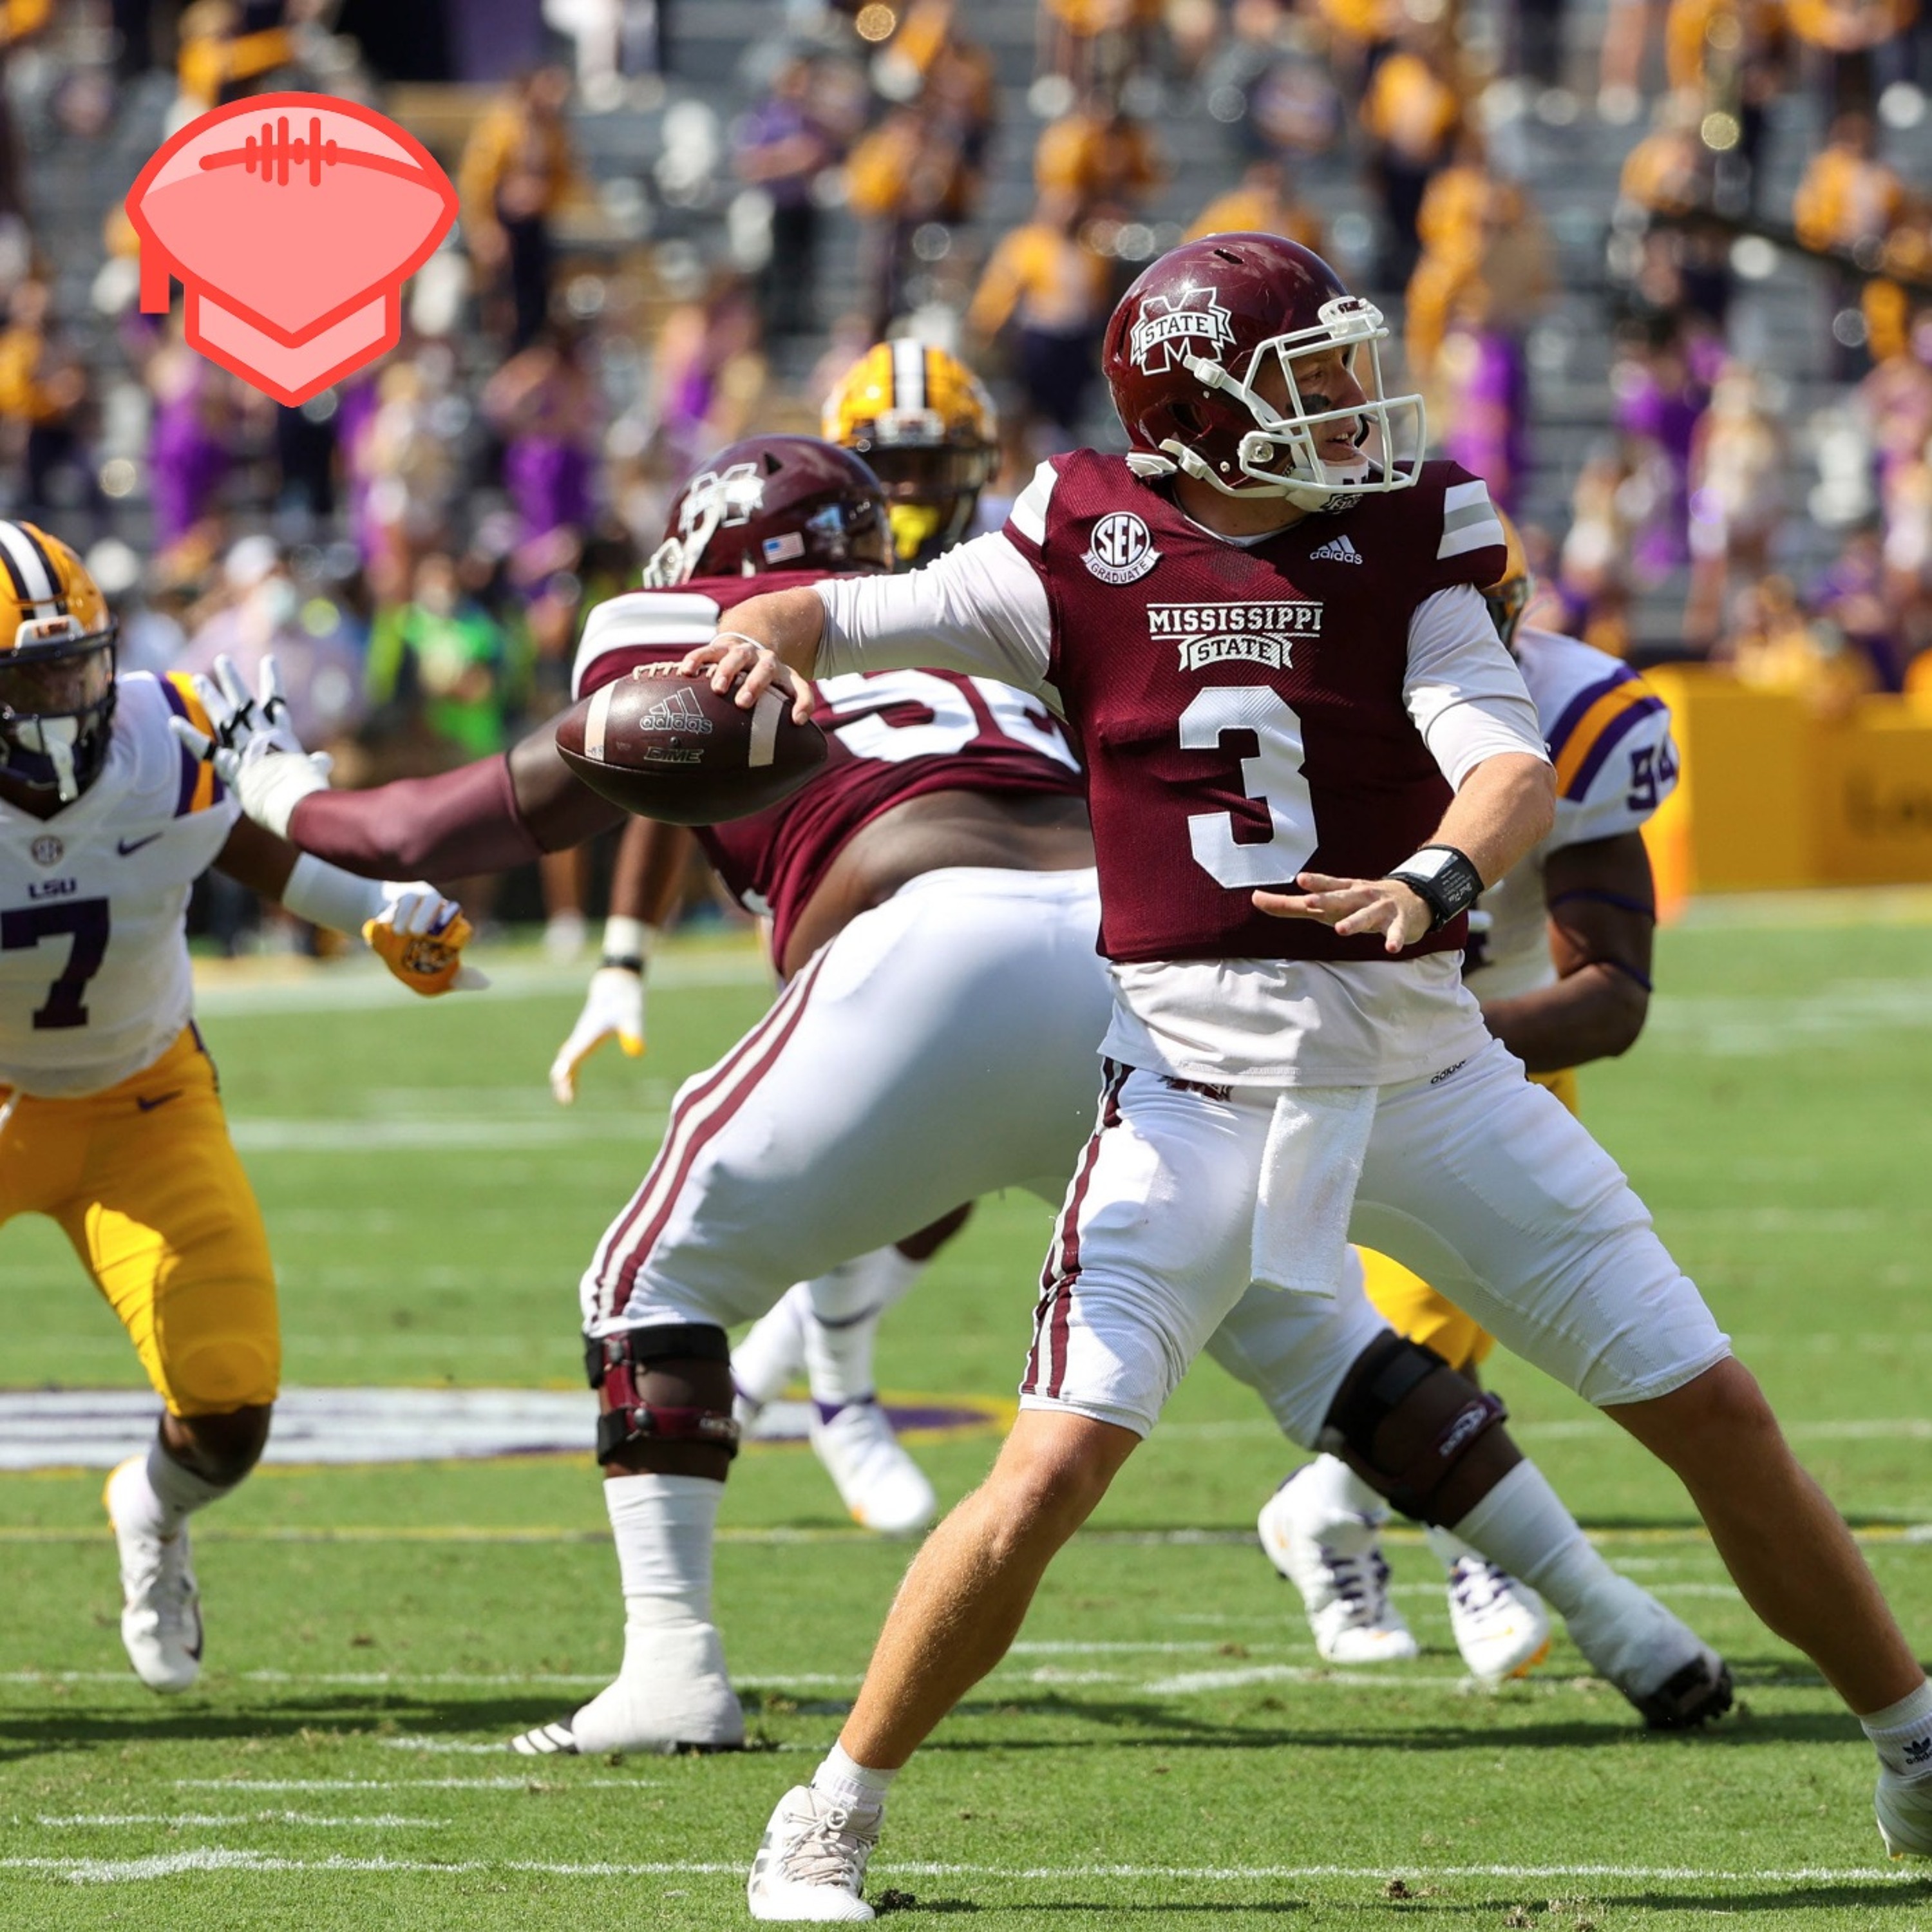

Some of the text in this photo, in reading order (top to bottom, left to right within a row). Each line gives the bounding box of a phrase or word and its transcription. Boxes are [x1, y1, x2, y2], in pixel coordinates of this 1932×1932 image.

[1145, 315, 1209, 345] STATE
[1097, 516, 1144, 565] SEC
[1309, 549, 1363, 565] adidas
[1090, 560, 1149, 583] GRADUATE
[1147, 607, 1323, 633] MISSISSIPPI
[1197, 638, 1272, 661] STATE
[639, 714, 713, 735] adidas
[1179, 685, 1319, 889] 3
[28, 876, 77, 900] LSU
[0, 896, 110, 1028] 7
